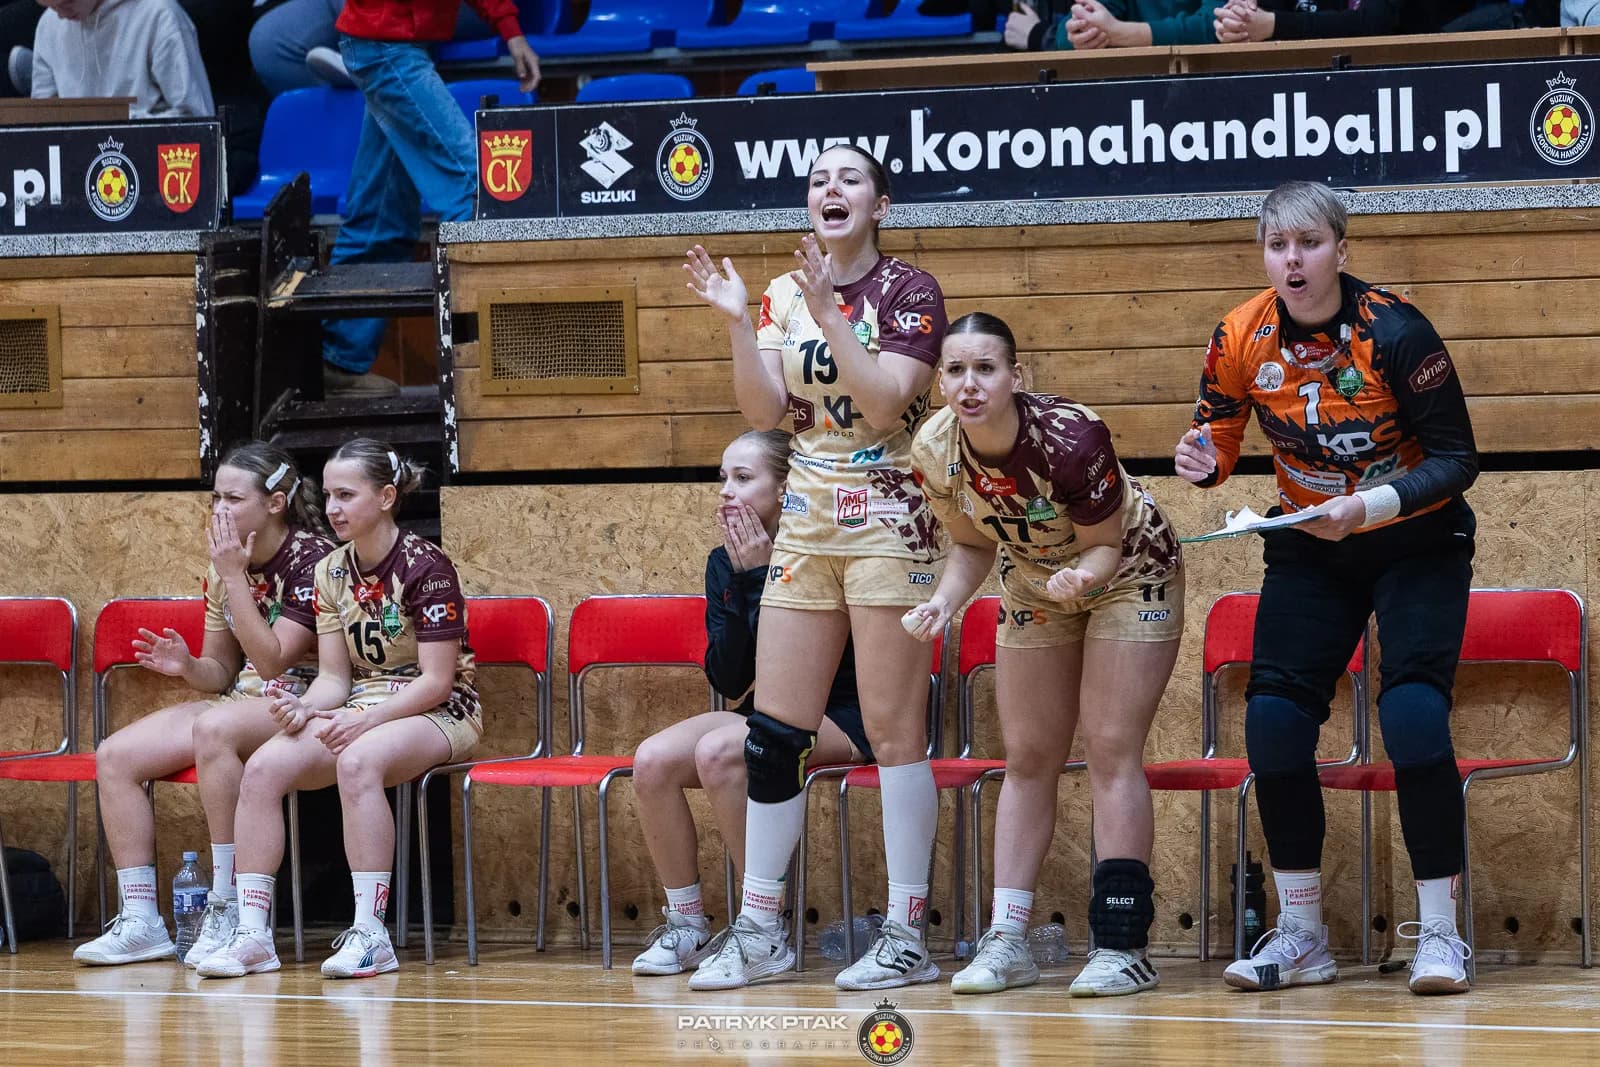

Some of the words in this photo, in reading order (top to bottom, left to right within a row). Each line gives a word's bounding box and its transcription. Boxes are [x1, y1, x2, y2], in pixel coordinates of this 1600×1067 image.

[1549, 94, 1575, 105] SUZUKI
[673, 133, 696, 144] SUZUKI
[1536, 133, 1560, 159] KORONA
[1560, 131, 1590, 159] HANDBALL
[163, 170, 193, 204] CK
[486, 158, 523, 193] CK
[662, 170, 684, 195] KORONA
[683, 168, 709, 195] HANDBALL
[580, 189, 636, 204] SUZUKI
[894, 310, 933, 334] KPS
[798, 339, 839, 385] 19
[1416, 357, 1448, 386] elmas
[1297, 380, 1322, 426] 1
[1316, 419, 1403, 456] KPS
[981, 515, 1032, 543] 17
[422, 578, 451, 593] elmas
[909, 573, 934, 584] TICO
[422, 602, 457, 623] KPS
[1011, 608, 1048, 626] KPS
[1138, 610, 1168, 622] TICO
[348, 621, 387, 666] 15
[1106, 896, 1135, 905] SELECT
